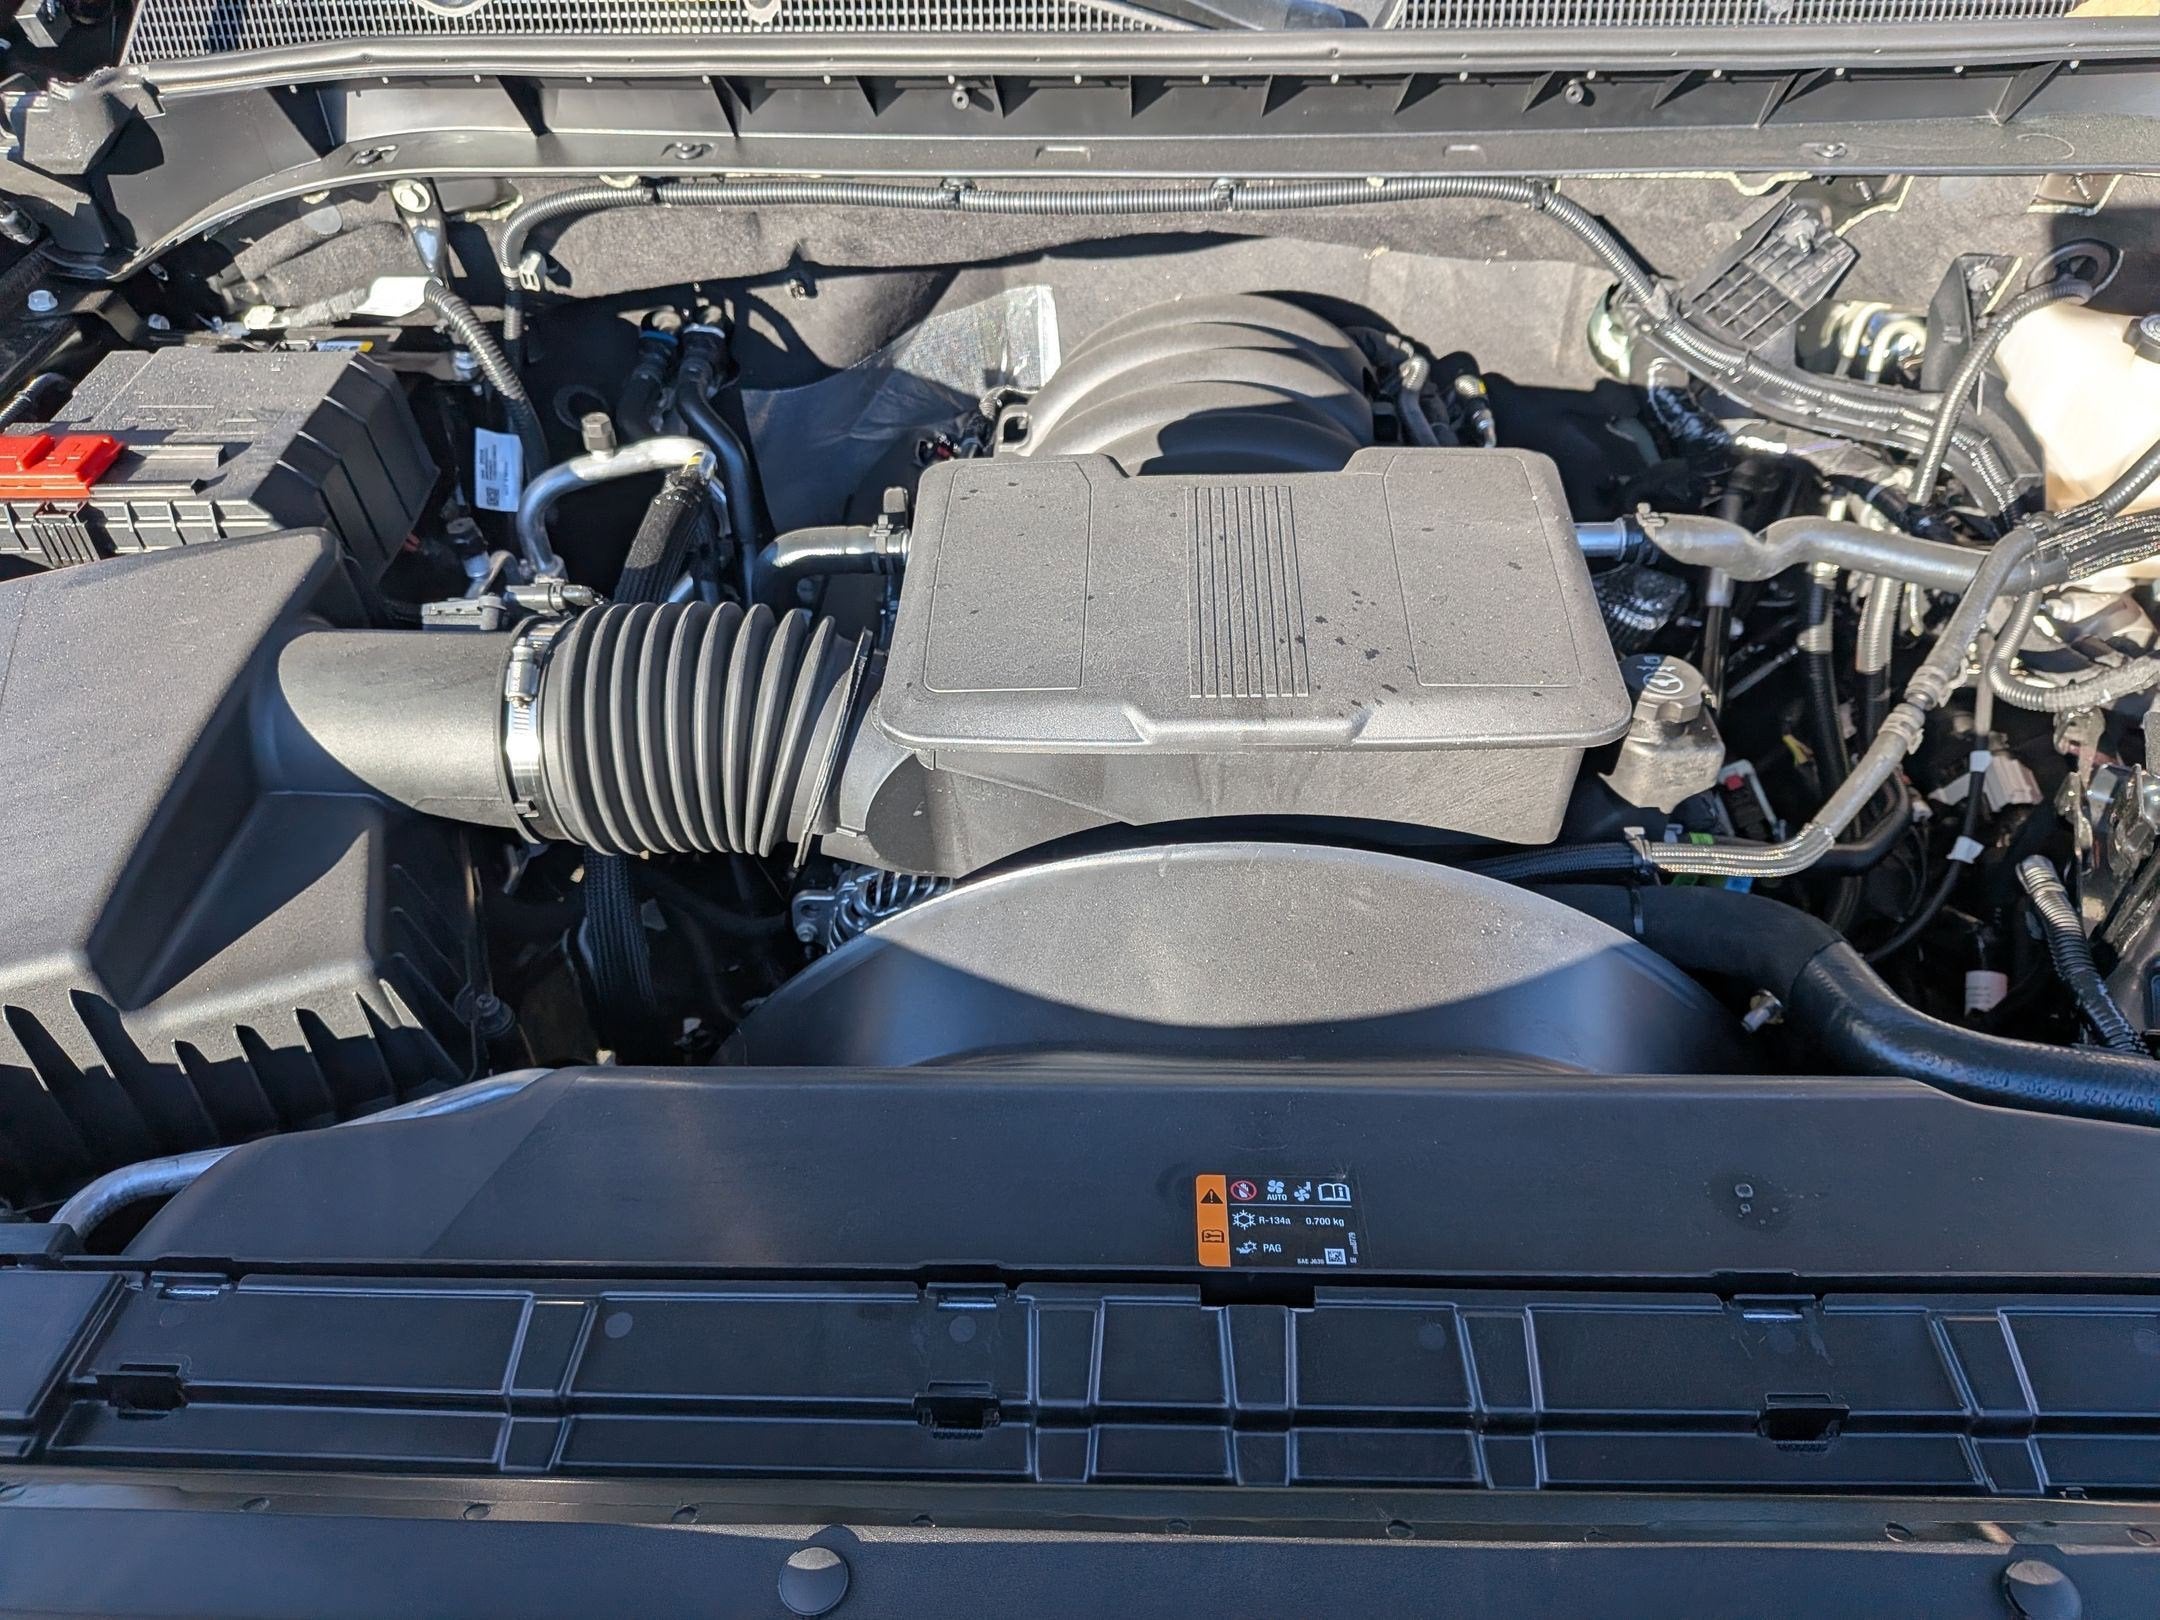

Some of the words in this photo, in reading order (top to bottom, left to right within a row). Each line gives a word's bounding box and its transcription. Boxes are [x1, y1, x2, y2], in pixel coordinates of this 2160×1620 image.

[1259, 1216, 1291, 1225] R-134a
[1305, 1217, 1331, 1226] 0.700
[1333, 1217, 1345, 1227] kg
[1263, 1243, 1282, 1253] PAG
